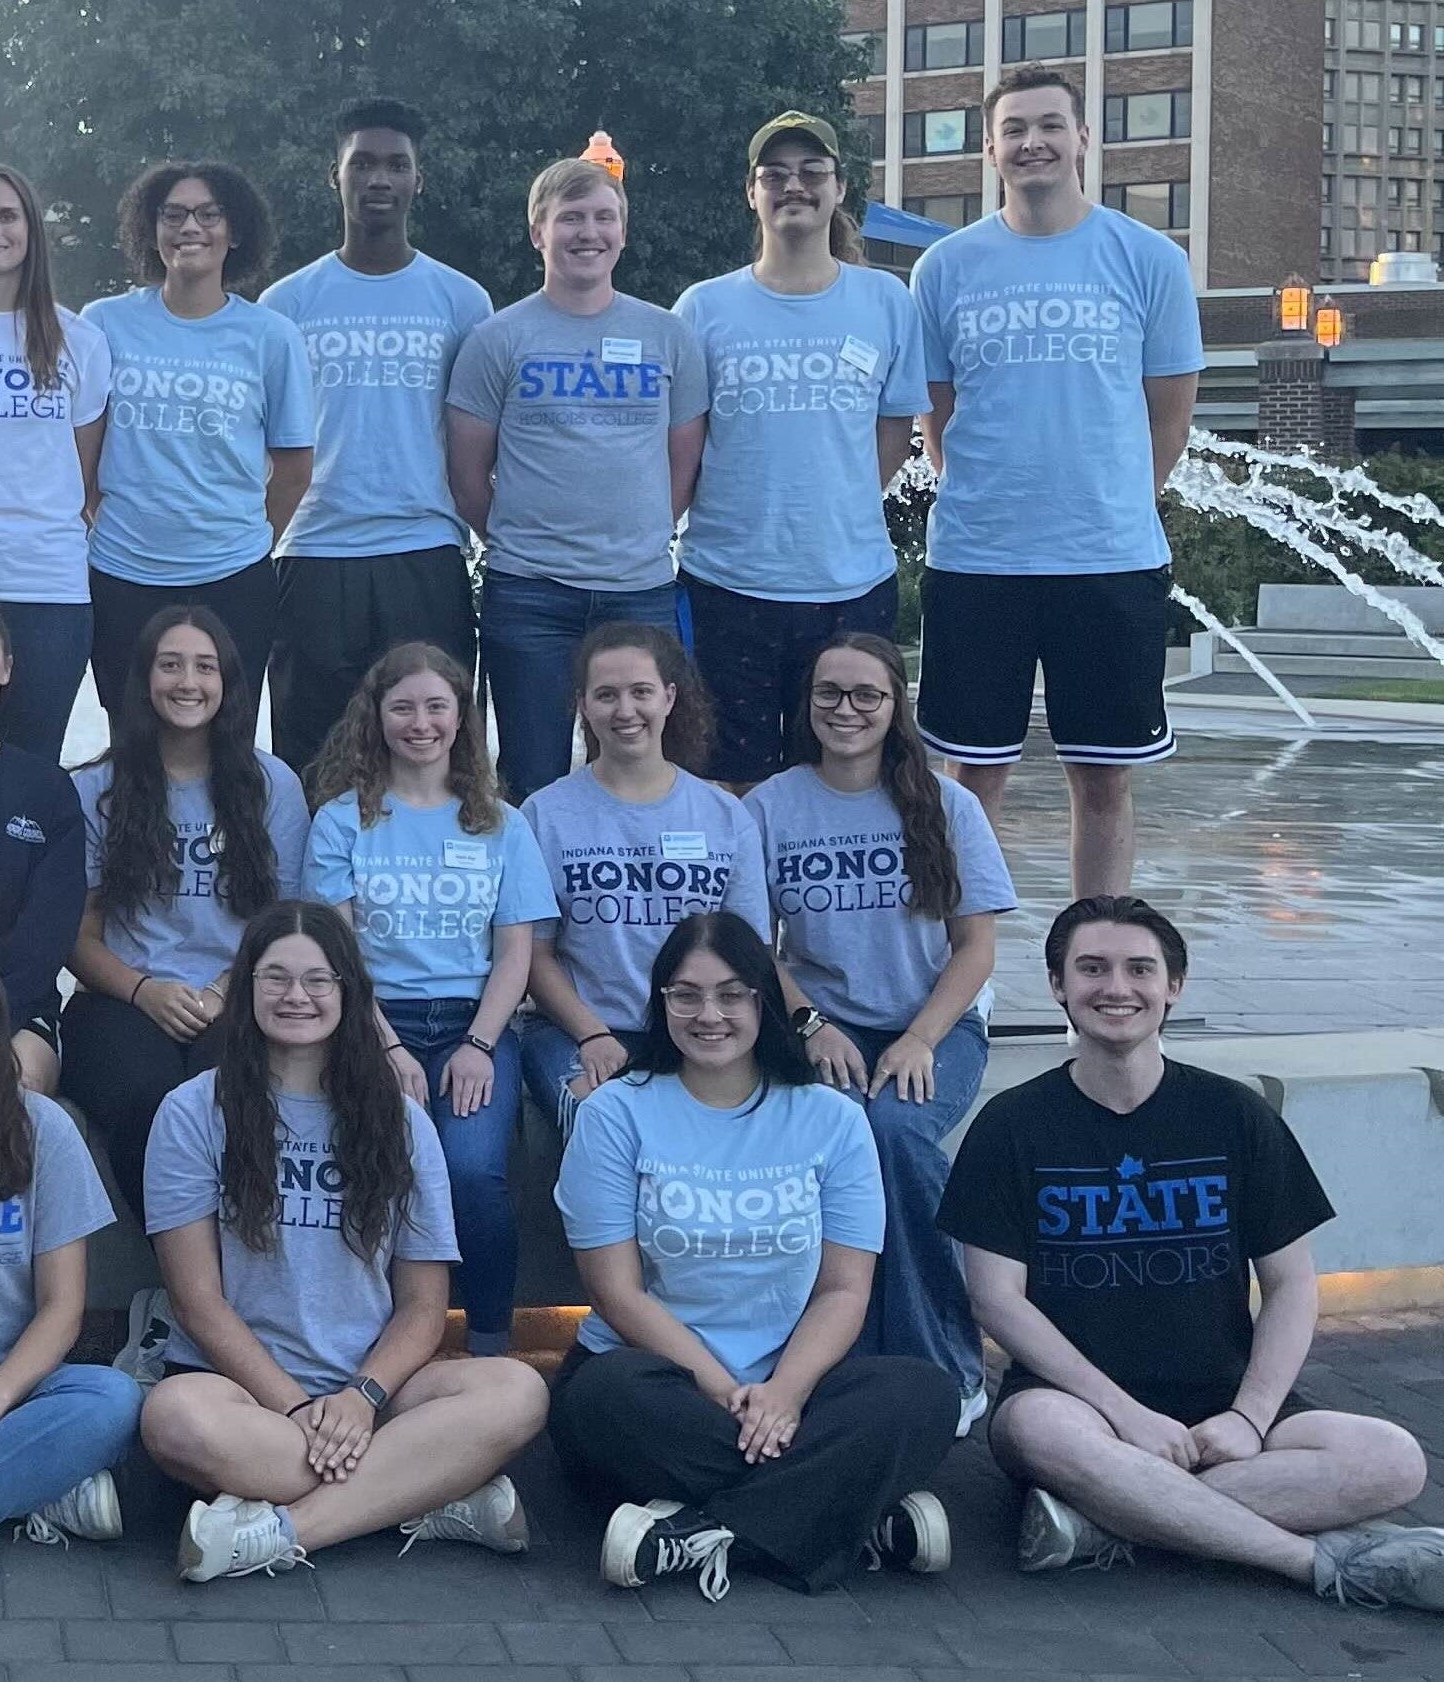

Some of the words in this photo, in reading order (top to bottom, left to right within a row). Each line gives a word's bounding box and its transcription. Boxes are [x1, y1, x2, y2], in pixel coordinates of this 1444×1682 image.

[1003, 282, 1041, 297] STATE
[1045, 281, 1112, 296] UNIVERSIT
[957, 298, 1121, 342] HONORS
[766, 338, 803, 349] STATE
[960, 332, 1121, 371] COLLEGE
[316, 361, 441, 390] OLLEGE
[519, 361, 662, 399] STATE
[717, 352, 866, 388] HONOR
[114, 367, 248, 410] ONORS
[715, 384, 871, 416] COLLEGE
[114, 400, 239, 441] OLLEGE
[562, 847, 614, 860] INDIANA
[617, 846, 656, 858] STATE
[778, 838, 826, 854] INDIANA
[827, 834, 866, 849] STATE
[354, 855, 389, 868] DIANA
[396, 855, 432, 868] STATE
[776, 847, 910, 886] HONO
[355, 873, 500, 906] ONOR
[562, 860, 730, 898] HONORS
[571, 895, 722, 926] COLLE
[779, 881, 916, 915] COLLE
[356, 909, 487, 940] OLLEG
[692, 1163, 733, 1182] STATE
[1036, 1174, 1228, 1236] STATE
[1038, 1242, 1230, 1288] HONORS
